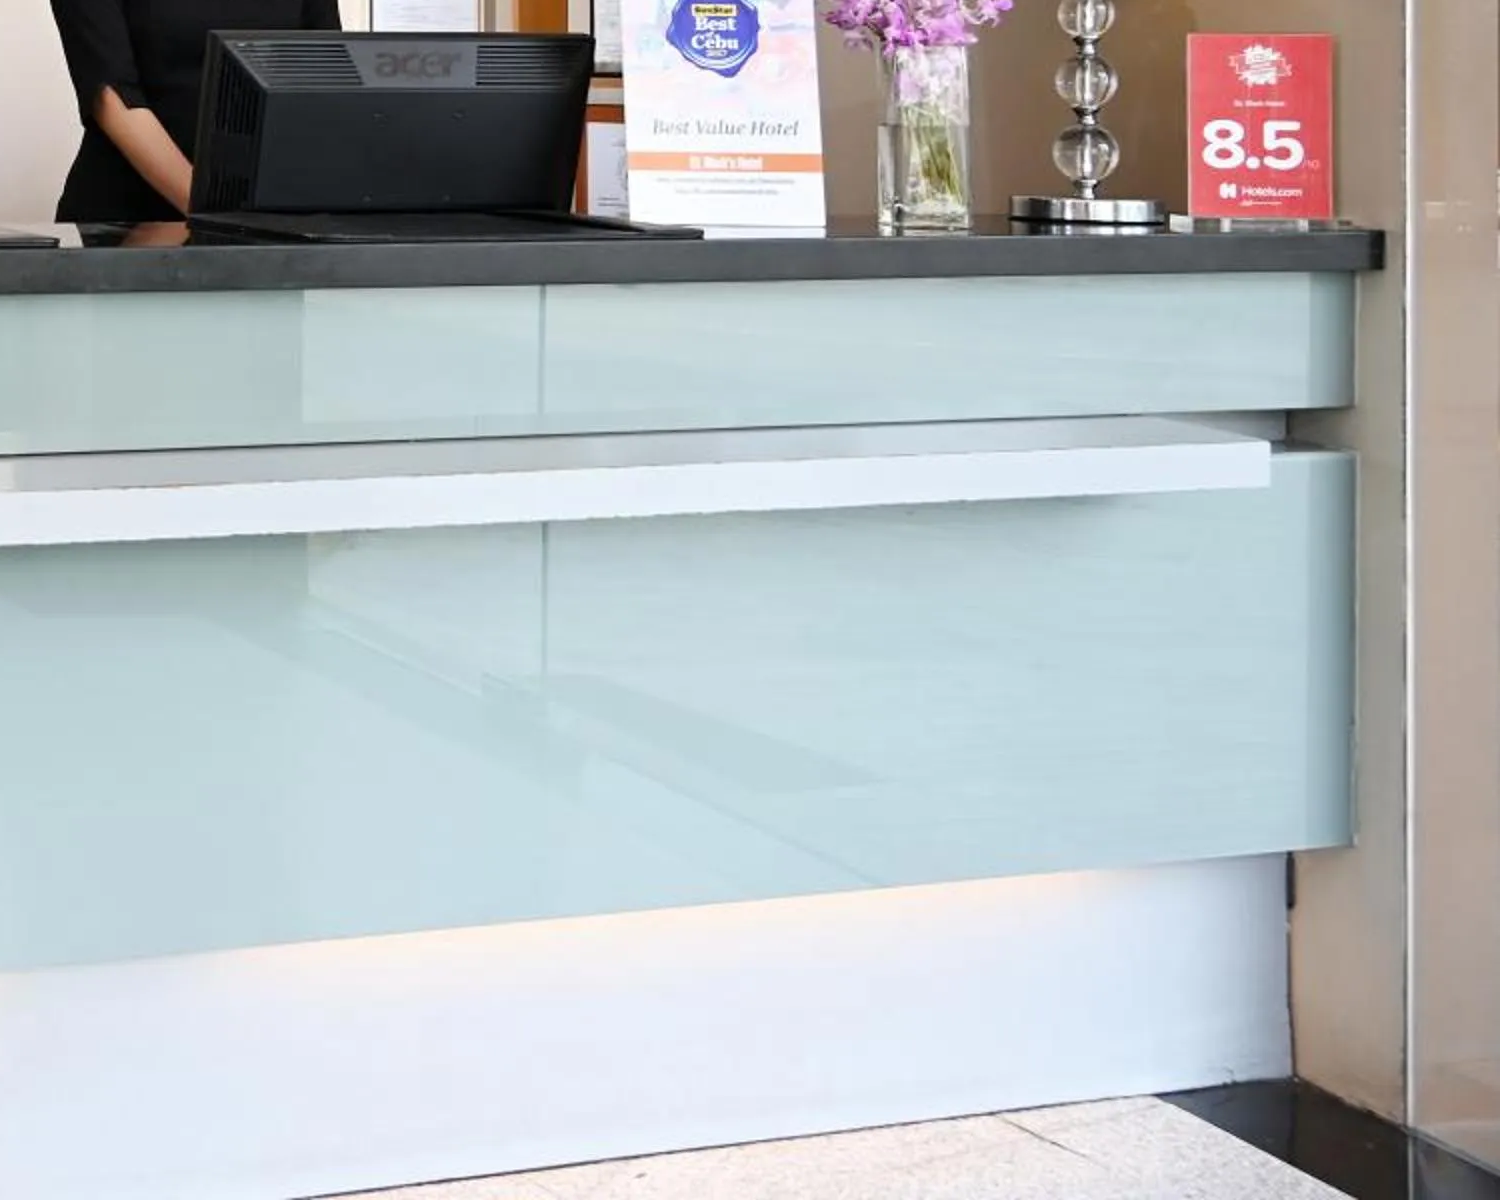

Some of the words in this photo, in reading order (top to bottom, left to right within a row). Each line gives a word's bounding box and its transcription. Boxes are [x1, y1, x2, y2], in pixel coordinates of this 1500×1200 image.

[696, 16, 736, 31] Best
[691, 33, 739, 50] Cebu
[374, 48, 462, 79] acer
[653, 118, 690, 136] Best
[697, 118, 746, 136] Value
[750, 119, 799, 137] Hotel
[1202, 118, 1305, 171] 8.5
